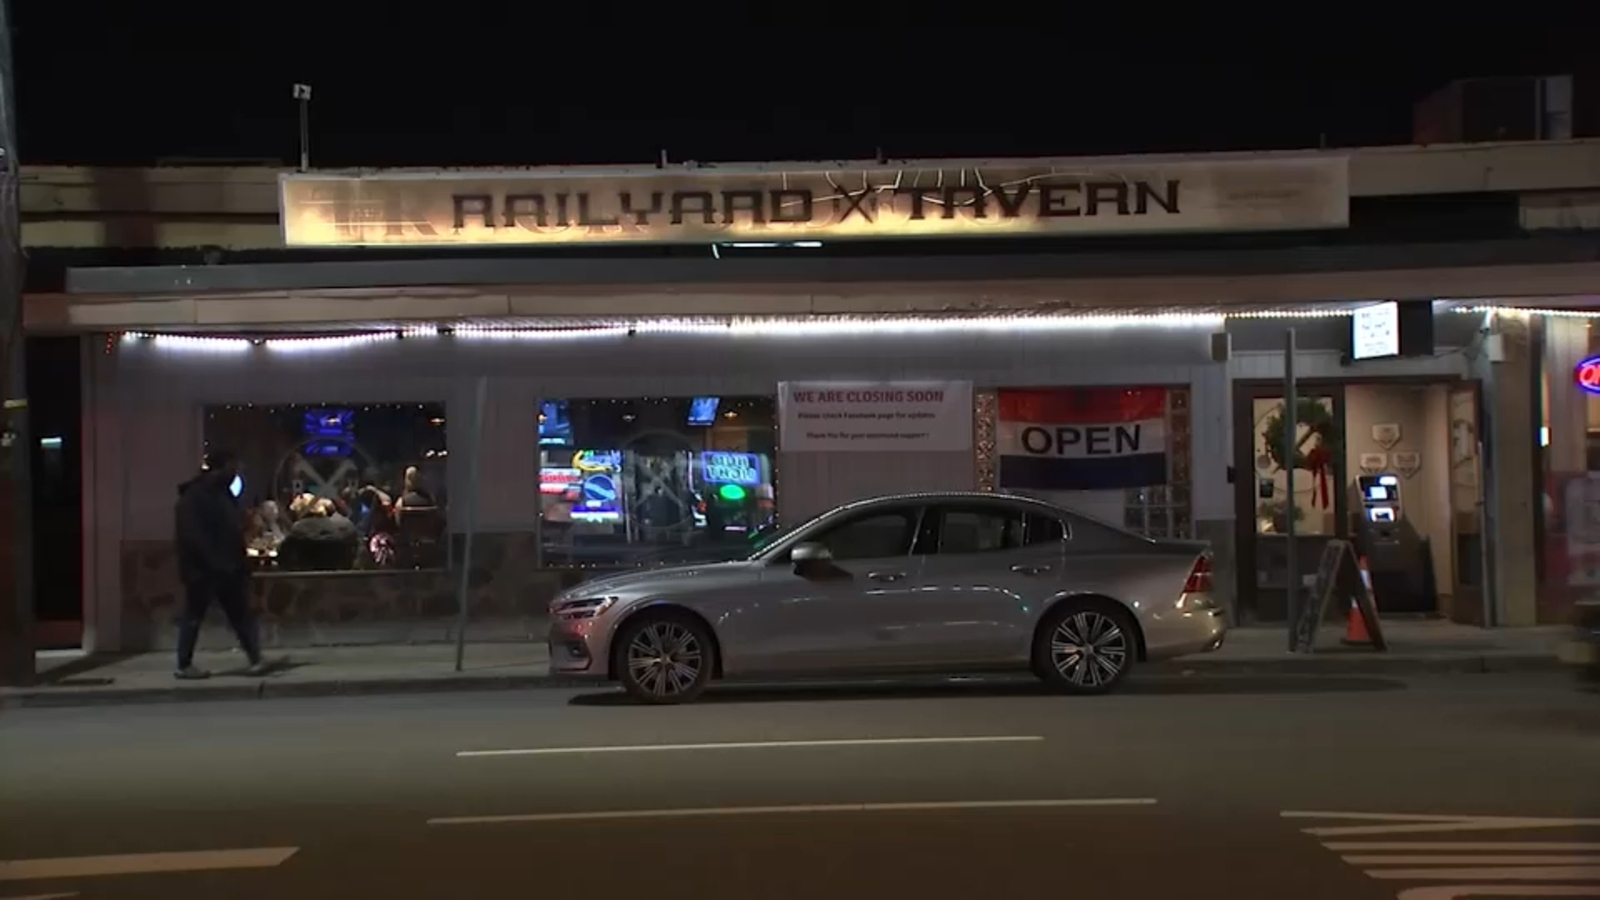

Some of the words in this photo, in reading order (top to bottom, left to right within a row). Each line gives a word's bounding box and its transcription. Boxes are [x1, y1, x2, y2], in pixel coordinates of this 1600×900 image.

[453, 188, 812, 229] RAILYARD
[895, 179, 1182, 221] TAVERN
[793, 391, 814, 403] WE
[818, 391, 843, 403] ARE
[847, 391, 904, 403] CLOSING
[906, 391, 943, 403] SOON
[1021, 423, 1141, 455] OPEN
